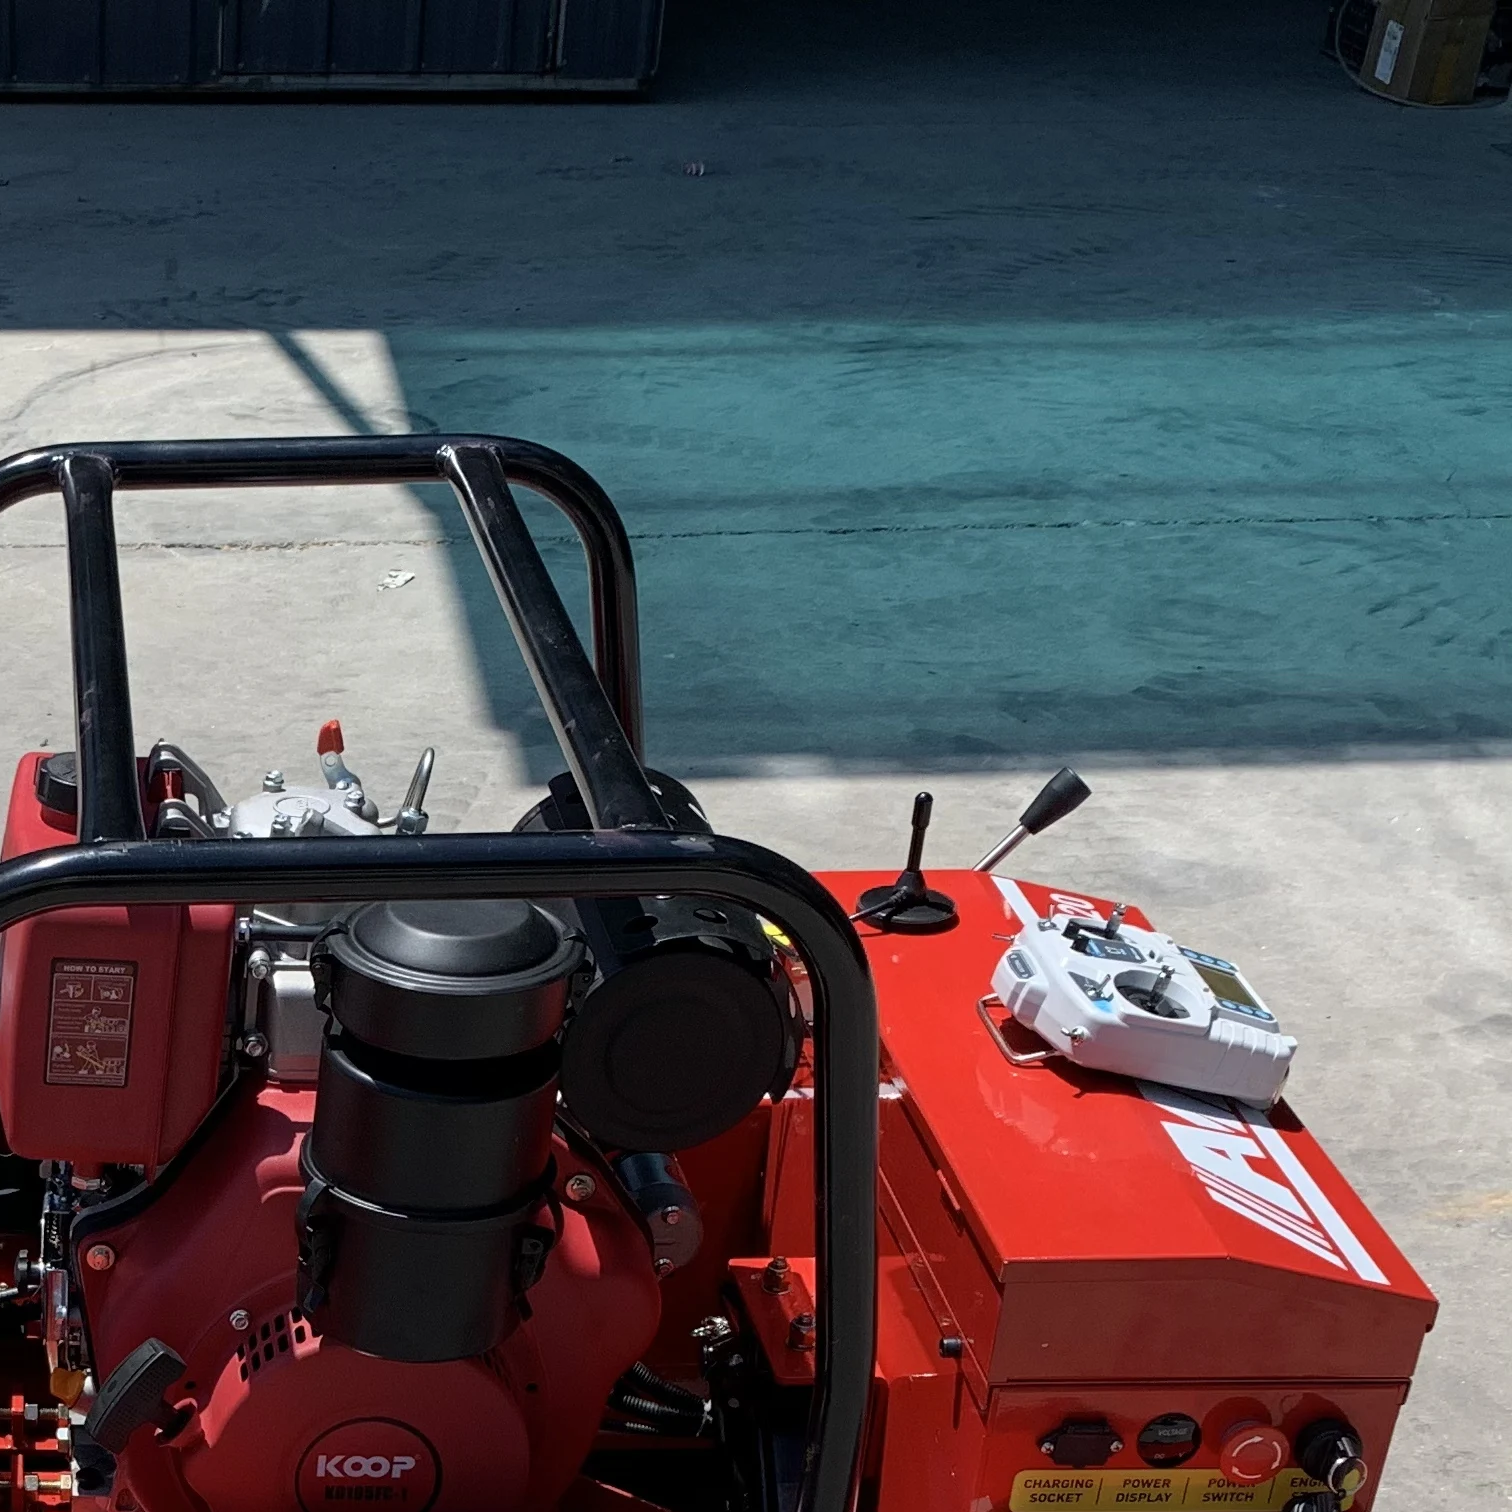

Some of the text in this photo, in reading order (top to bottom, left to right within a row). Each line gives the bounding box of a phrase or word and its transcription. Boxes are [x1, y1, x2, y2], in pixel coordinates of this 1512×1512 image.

[86, 965, 96, 973] TO
[99, 966, 126, 974] START
[316, 1454, 416, 1478] KOOP
[1023, 1478, 1094, 1490] CHARGING
[1122, 1478, 1172, 1489] POWER
[1207, 1478, 1256, 1488] POW
[1029, 1492, 1083, 1504] SOCKET
[1115, 1492, 1174, 1504] DISPLAY
[1201, 1491, 1255, 1502] SWITCH
